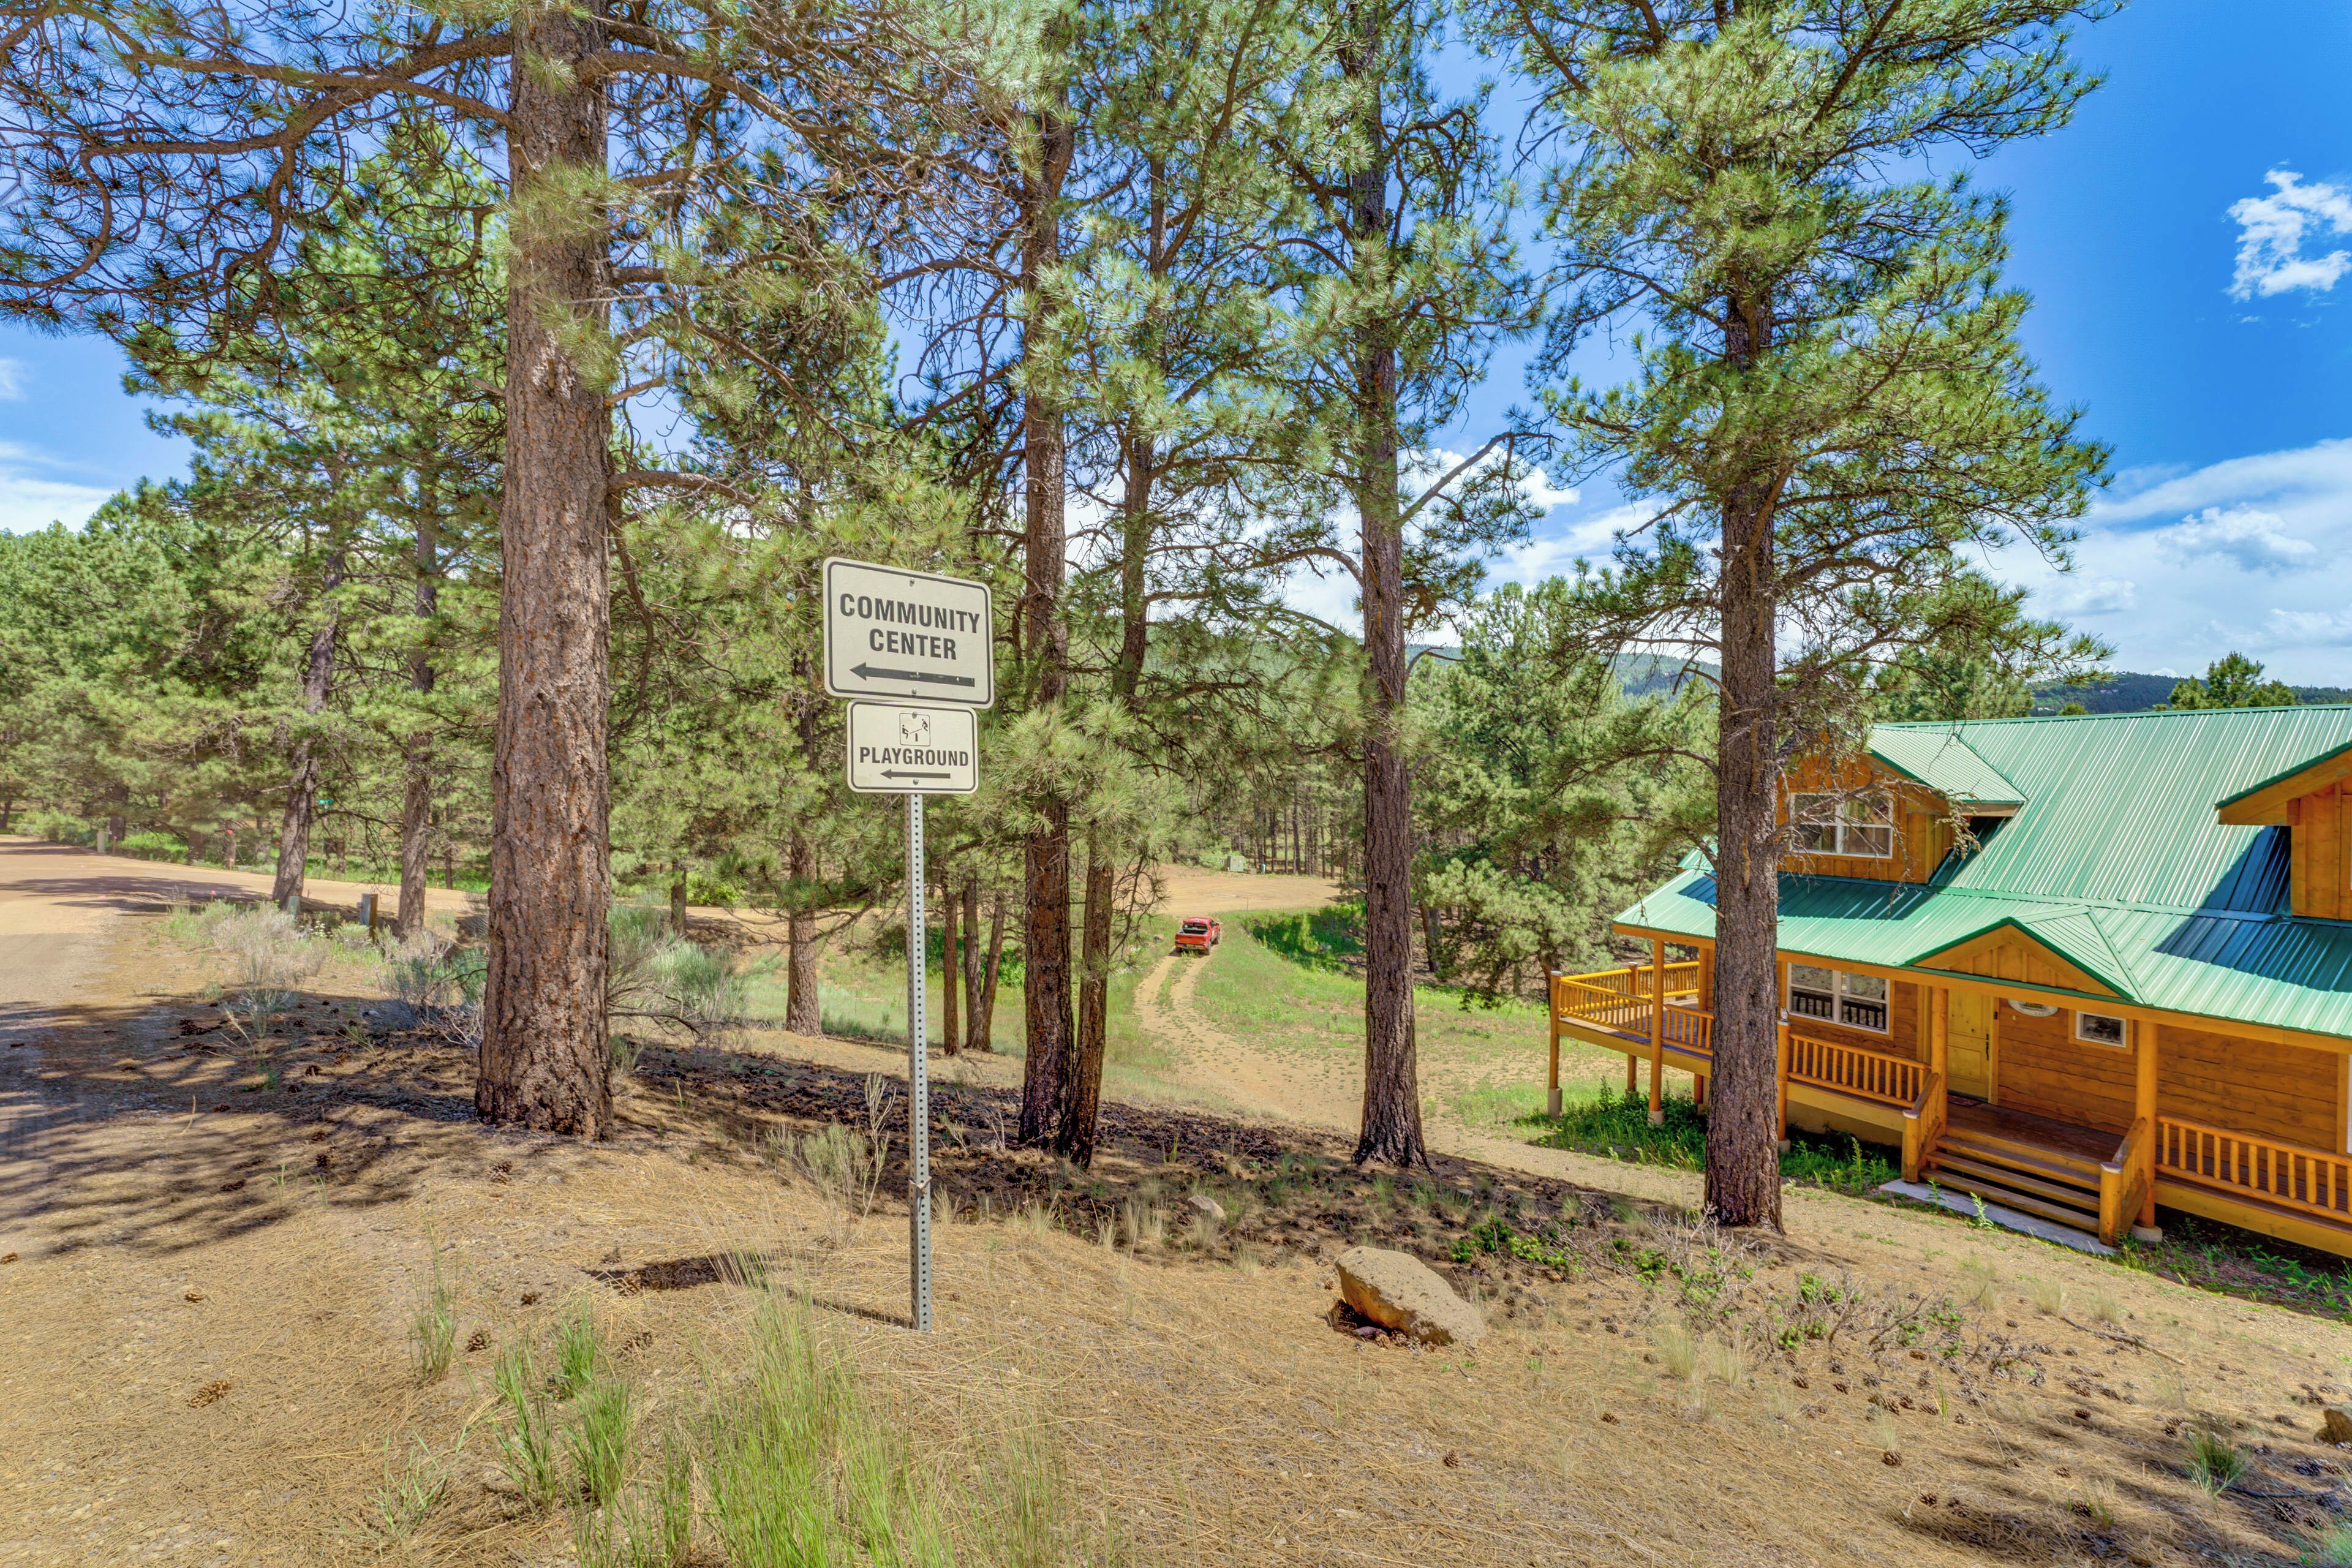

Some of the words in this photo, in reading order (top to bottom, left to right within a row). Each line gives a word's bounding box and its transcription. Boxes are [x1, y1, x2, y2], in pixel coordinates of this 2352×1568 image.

[840, 593, 980, 633] COMMUNITY
[869, 628, 957, 660] CENTER
[859, 747, 968, 766] PLAYGROUND
